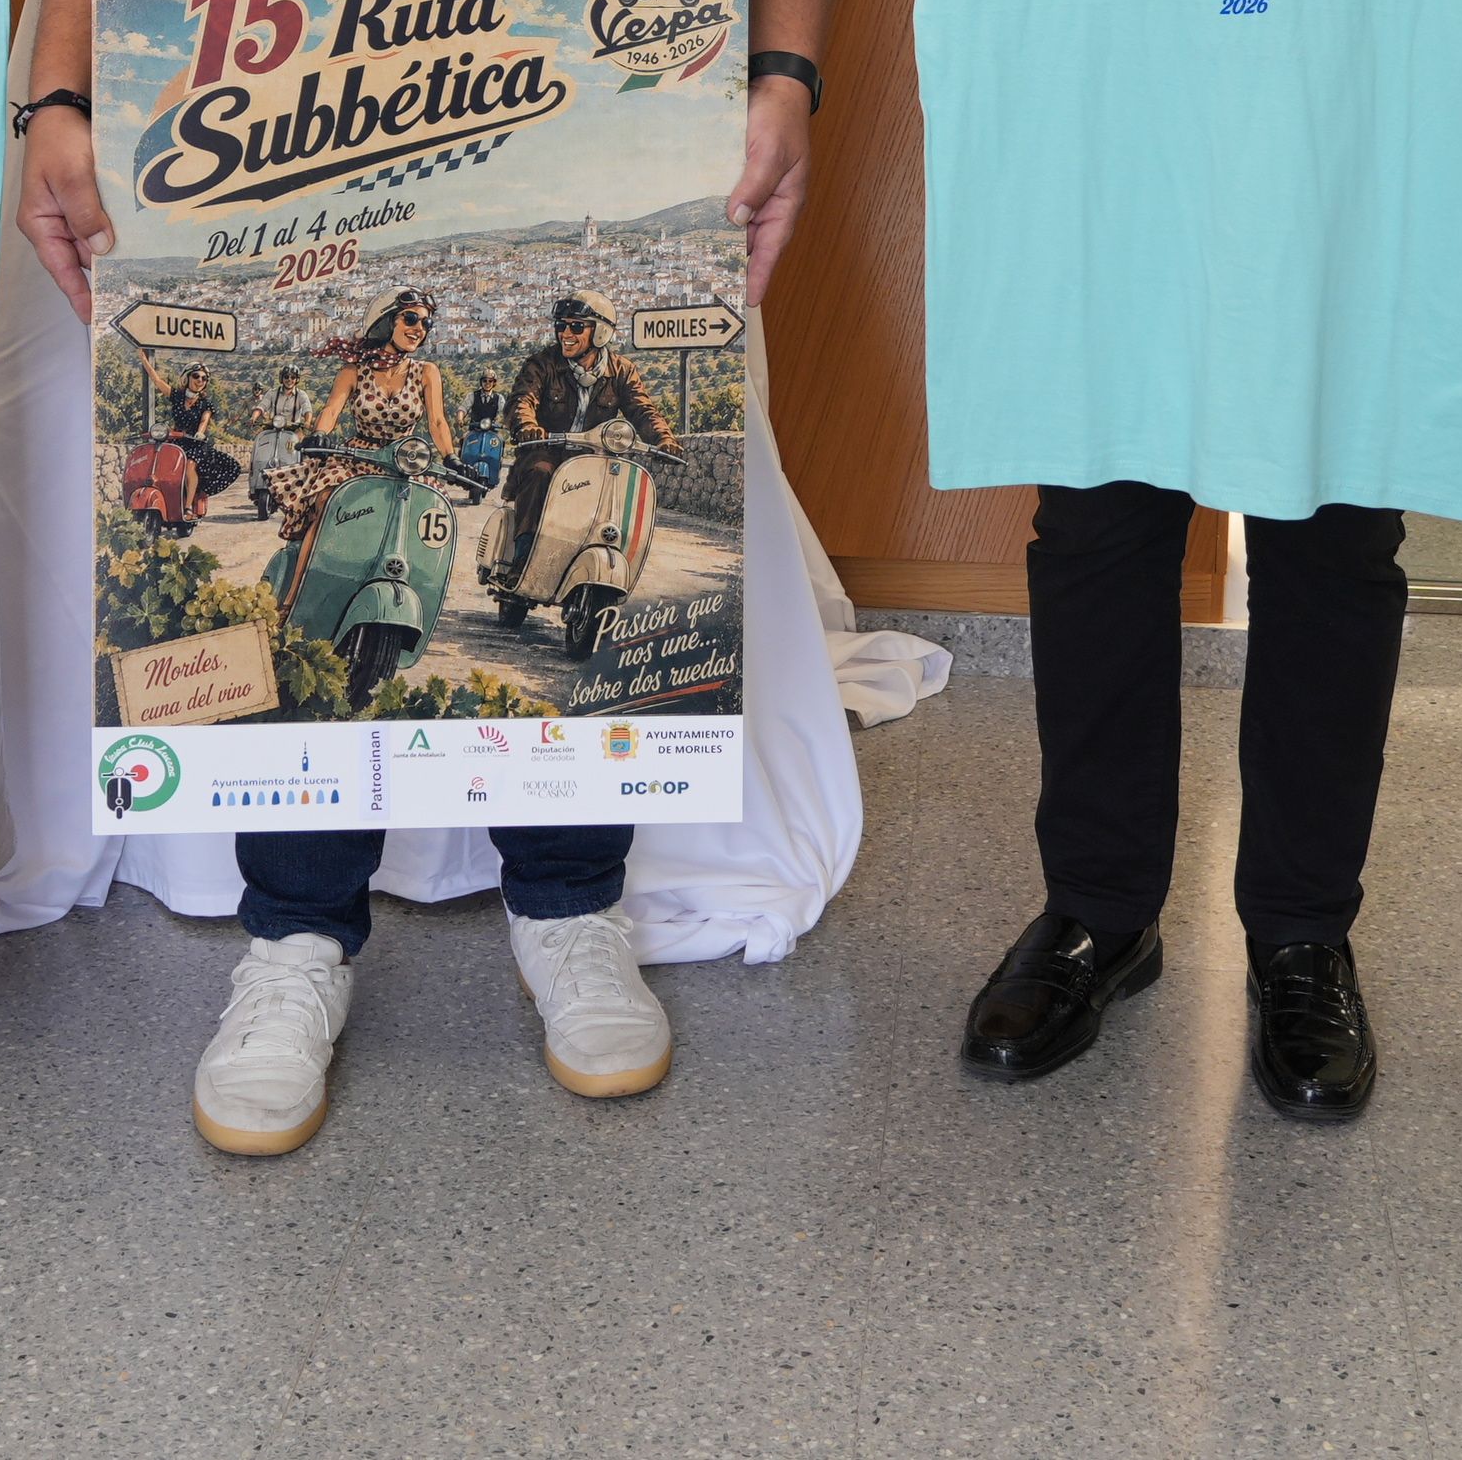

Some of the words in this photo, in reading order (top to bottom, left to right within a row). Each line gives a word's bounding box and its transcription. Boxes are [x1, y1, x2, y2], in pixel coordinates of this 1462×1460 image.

[627, 51, 659, 65] 1946
[669, 35, 705, 61] 2026
[143, 55, 566, 203] Subbética
[203, 226, 249, 263] Del
[249, 222, 268, 258] 1
[273, 217, 299, 248] al
[306, 210, 327, 242] 4
[335, 198, 416, 236] octubre
[274, 238, 358, 290] 2026
[155, 315, 225, 341] LUCENA
[643, 317, 707, 339] MORILES
[561, 478, 592, 495] Vespa
[335, 505, 375, 526] Vespa
[420, 512, 448, 542] 15
[592, 600, 679, 653] Pasión
[687, 594, 723, 629] que
[618, 641, 654, 669] nos
[661, 631, 717, 658] une...
[144, 648, 228, 690] Moriles,
[568, 673, 623, 708] sobre
[629, 666, 662, 696] dos
[668, 648, 736, 687] ruedas
[141, 700, 182, 722] cuna
[187, 683, 215, 711] del
[219, 682, 255, 703] vino
[645, 730, 735, 740] AYUNTAMIENTO
[658, 745, 672, 754] DE
[675, 744, 723, 754] MORILES
[531, 746, 575, 756] Diputación
[211, 777, 285, 788] Ayuntamiento
[288, 776, 301, 786] de
[304, 776, 339, 786] Lucena
[370, 730, 382, 811] Patrocinan
[467, 789, 487, 802] fm
